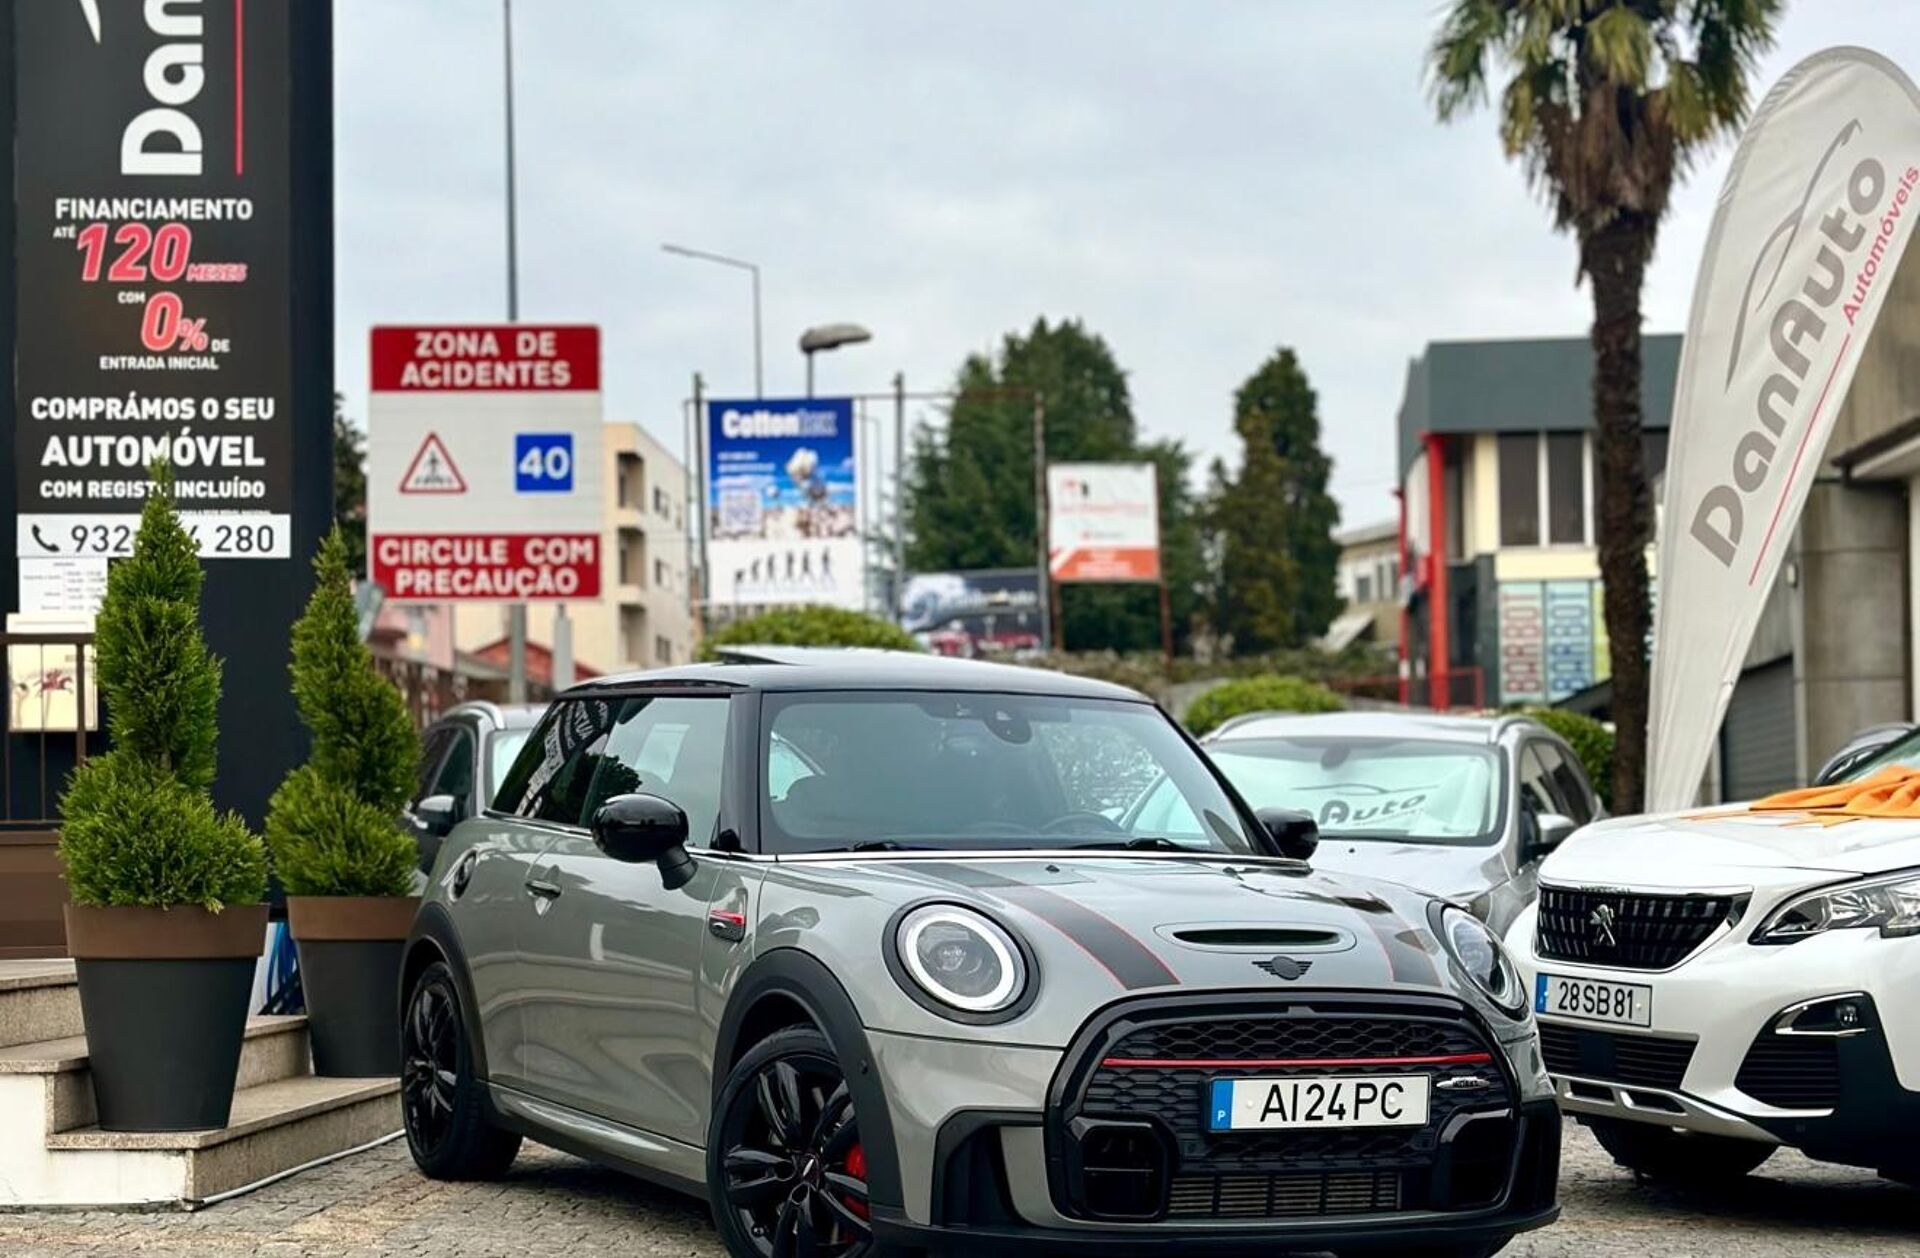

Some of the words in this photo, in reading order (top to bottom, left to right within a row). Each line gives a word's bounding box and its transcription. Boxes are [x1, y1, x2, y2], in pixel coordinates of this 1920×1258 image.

[55, 197, 253, 220] FINANCIAMENTO
[53, 225, 77, 239] ATÉ
[76, 222, 192, 282] 120
[186, 263, 248, 282] MESES
[1843, 166, 1920, 328] Automóveis
[118, 291, 146, 304] COM
[211, 339, 231, 353] DE
[415, 332, 501, 358] ZONA
[516, 331, 557, 357] DE
[99, 356, 165, 370] ENTRADA
[168, 356, 219, 370] INICIAL
[401, 361, 572, 388] ACIDENTES
[1689, 156, 1886, 568] DanAuto
[31, 391, 196, 421] COMPRÁMOS
[202, 397, 220, 421] O
[224, 397, 275, 421] SEU
[40, 427, 266, 467] AUTOMÓVEL
[519, 446, 570, 480] 40
[40, 479, 83, 498] COM
[87, 479, 168, 498] REGIST
[174, 475, 266, 499] INCLUÍDO
[70, 524, 131, 553] 932
[214, 524, 274, 553] 280
[379, 538, 509, 566] CIRCULE
[524, 537, 594, 565] COM
[395, 564, 579, 600] PRECAUÇÃO
[1300, 794, 1427, 825] Auto
[1216, 1110, 1226, 1123] P
